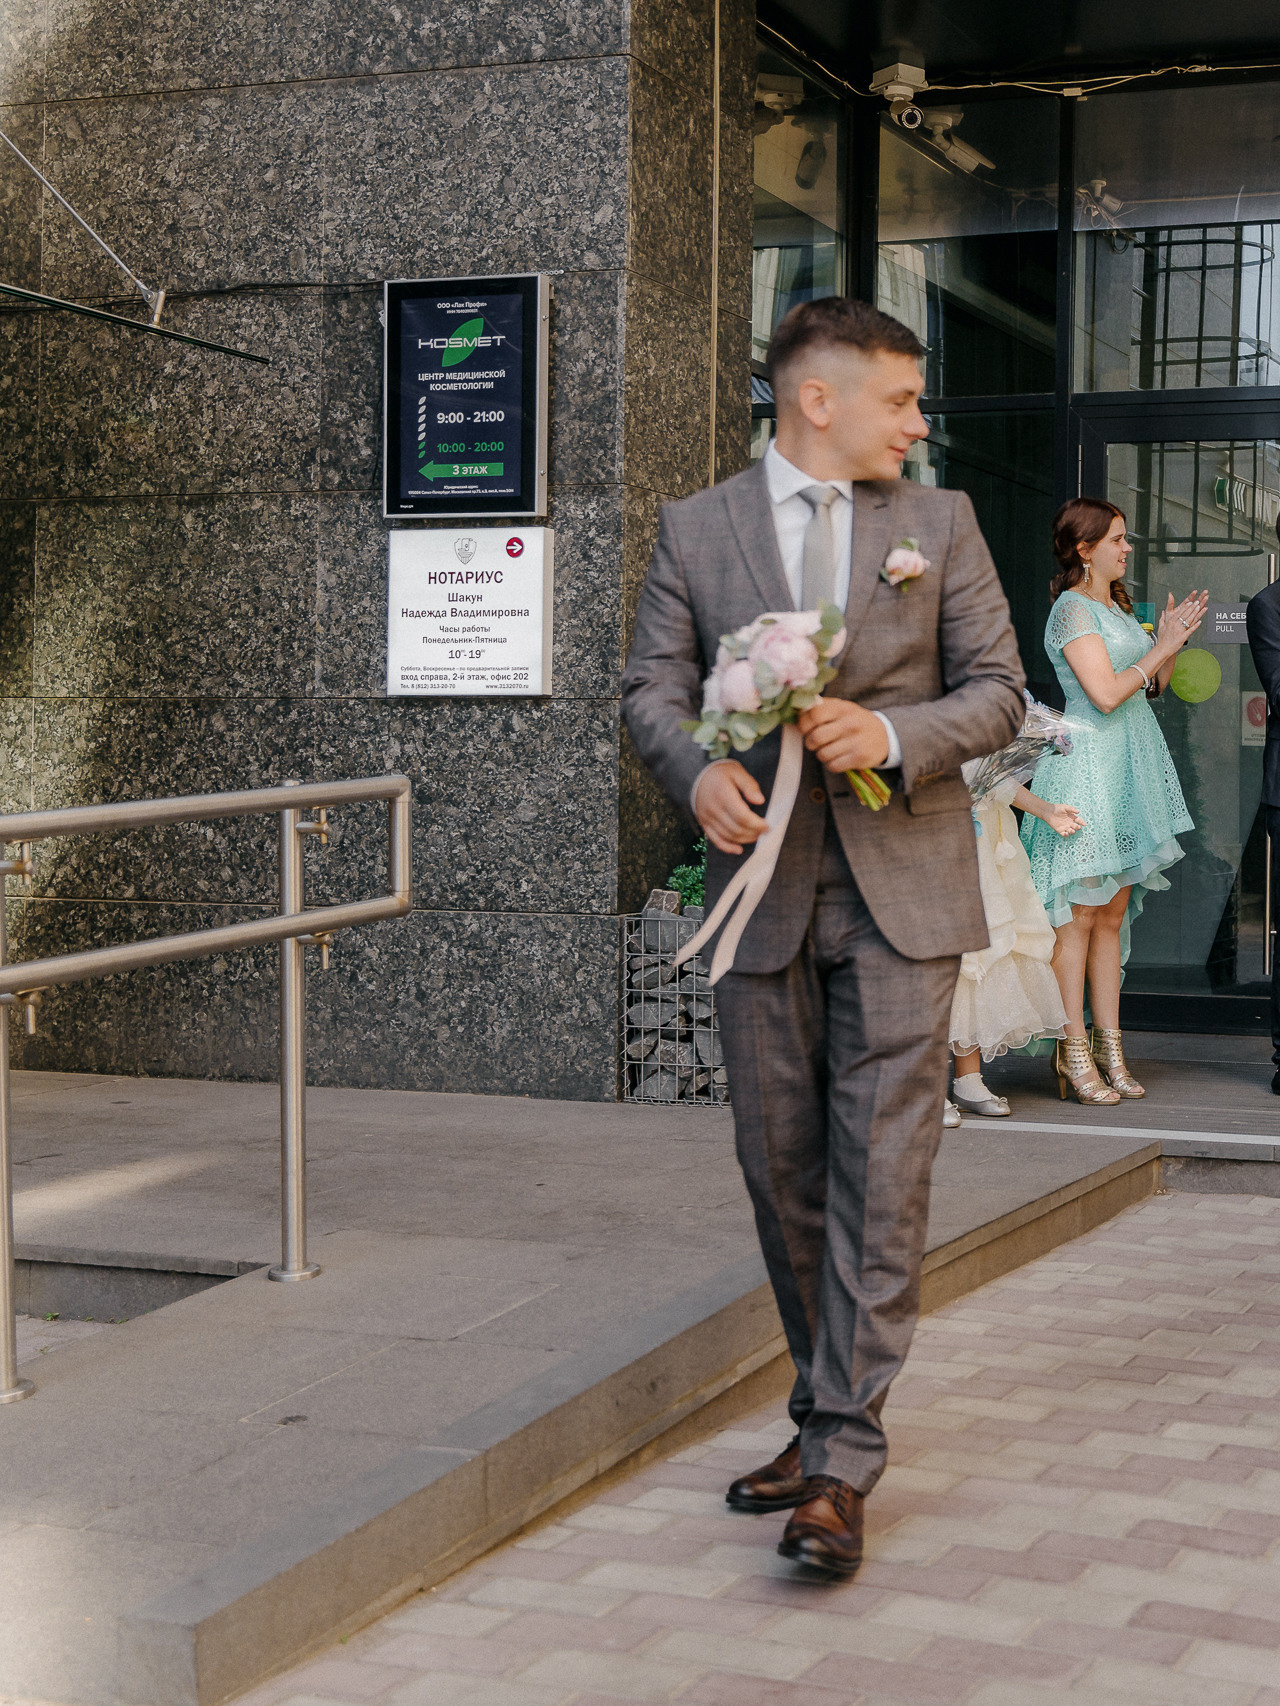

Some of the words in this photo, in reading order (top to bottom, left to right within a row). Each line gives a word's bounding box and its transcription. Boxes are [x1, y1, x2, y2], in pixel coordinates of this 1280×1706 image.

[418, 336, 506, 349] KOSMET
[418, 373, 445, 382] ЦЕНТР
[446, 370, 506, 381] МЕДИЦИНСКОЙ
[430, 382, 494, 391] КОСМЕТОЛОГИИ
[437, 412, 464, 424] 9:00
[473, 410, 505, 423] 21:00
[437, 443, 466, 453] 10:00
[474, 442, 504, 452] 20:00
[452, 465, 460, 475] 3
[462, 466, 488, 475] ЭТАЖ
[428, 571, 503, 584] НОТАРИУС
[448, 592, 483, 604] Шакун
[401, 608, 447, 618] Надежда
[451, 608, 530, 618] Владимировна
[1215, 612, 1228, 620] НА
[1230, 612, 1246, 620] СЕБ
[462, 625, 490, 634] работы
[1215, 625, 1234, 633] PULL
[422, 636, 507, 644] Понедельник-Пятница
[420, 674, 450, 682] справа,
[490, 672, 511, 682] офис
[513, 672, 529, 680] 202
